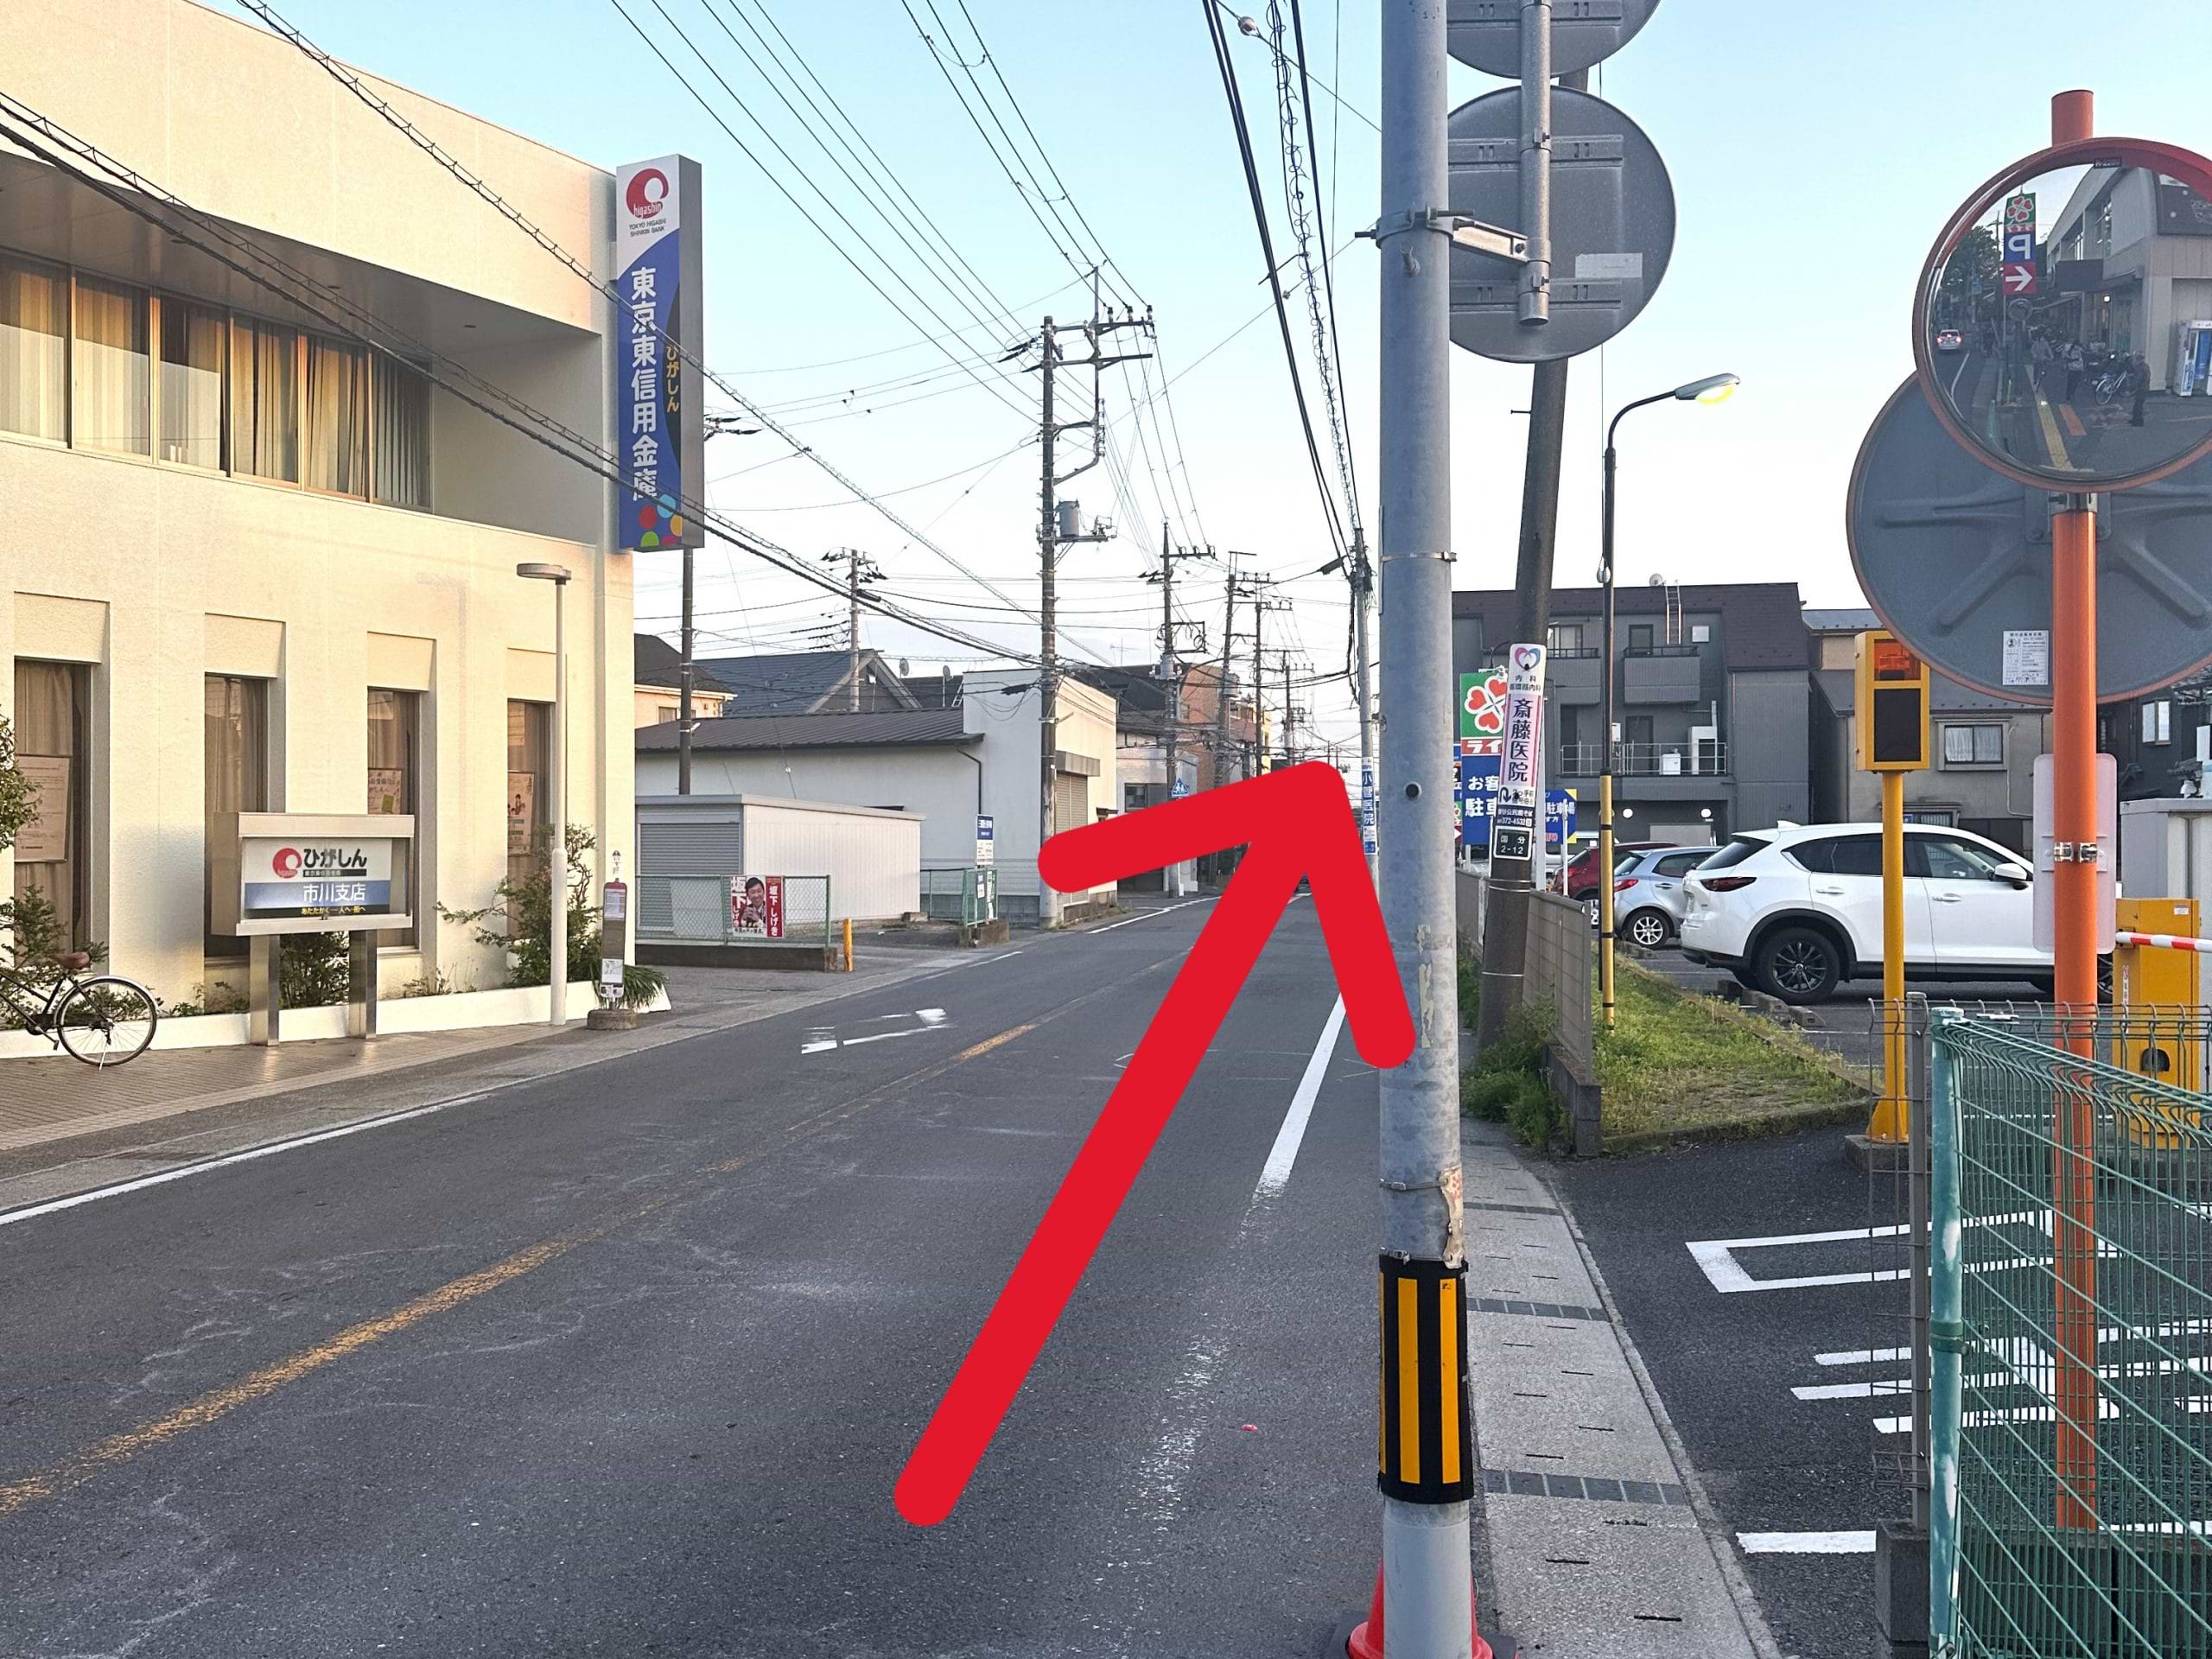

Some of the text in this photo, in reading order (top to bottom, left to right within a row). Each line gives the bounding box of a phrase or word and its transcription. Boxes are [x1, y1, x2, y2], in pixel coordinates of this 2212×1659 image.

[633, 202, 662, 218] higashin
[629, 218, 666, 231] TOKYO HIGASHI
[631, 266, 658, 501] 東京東信用金庫
[665, 345, 680, 413] ひがしん
[1508, 697, 1534, 782] 斎藤医院
[303, 849, 367, 868] ひがしん
[1500, 845, 1524, 855] 2-12
[302, 882, 366, 903] 市川支店
